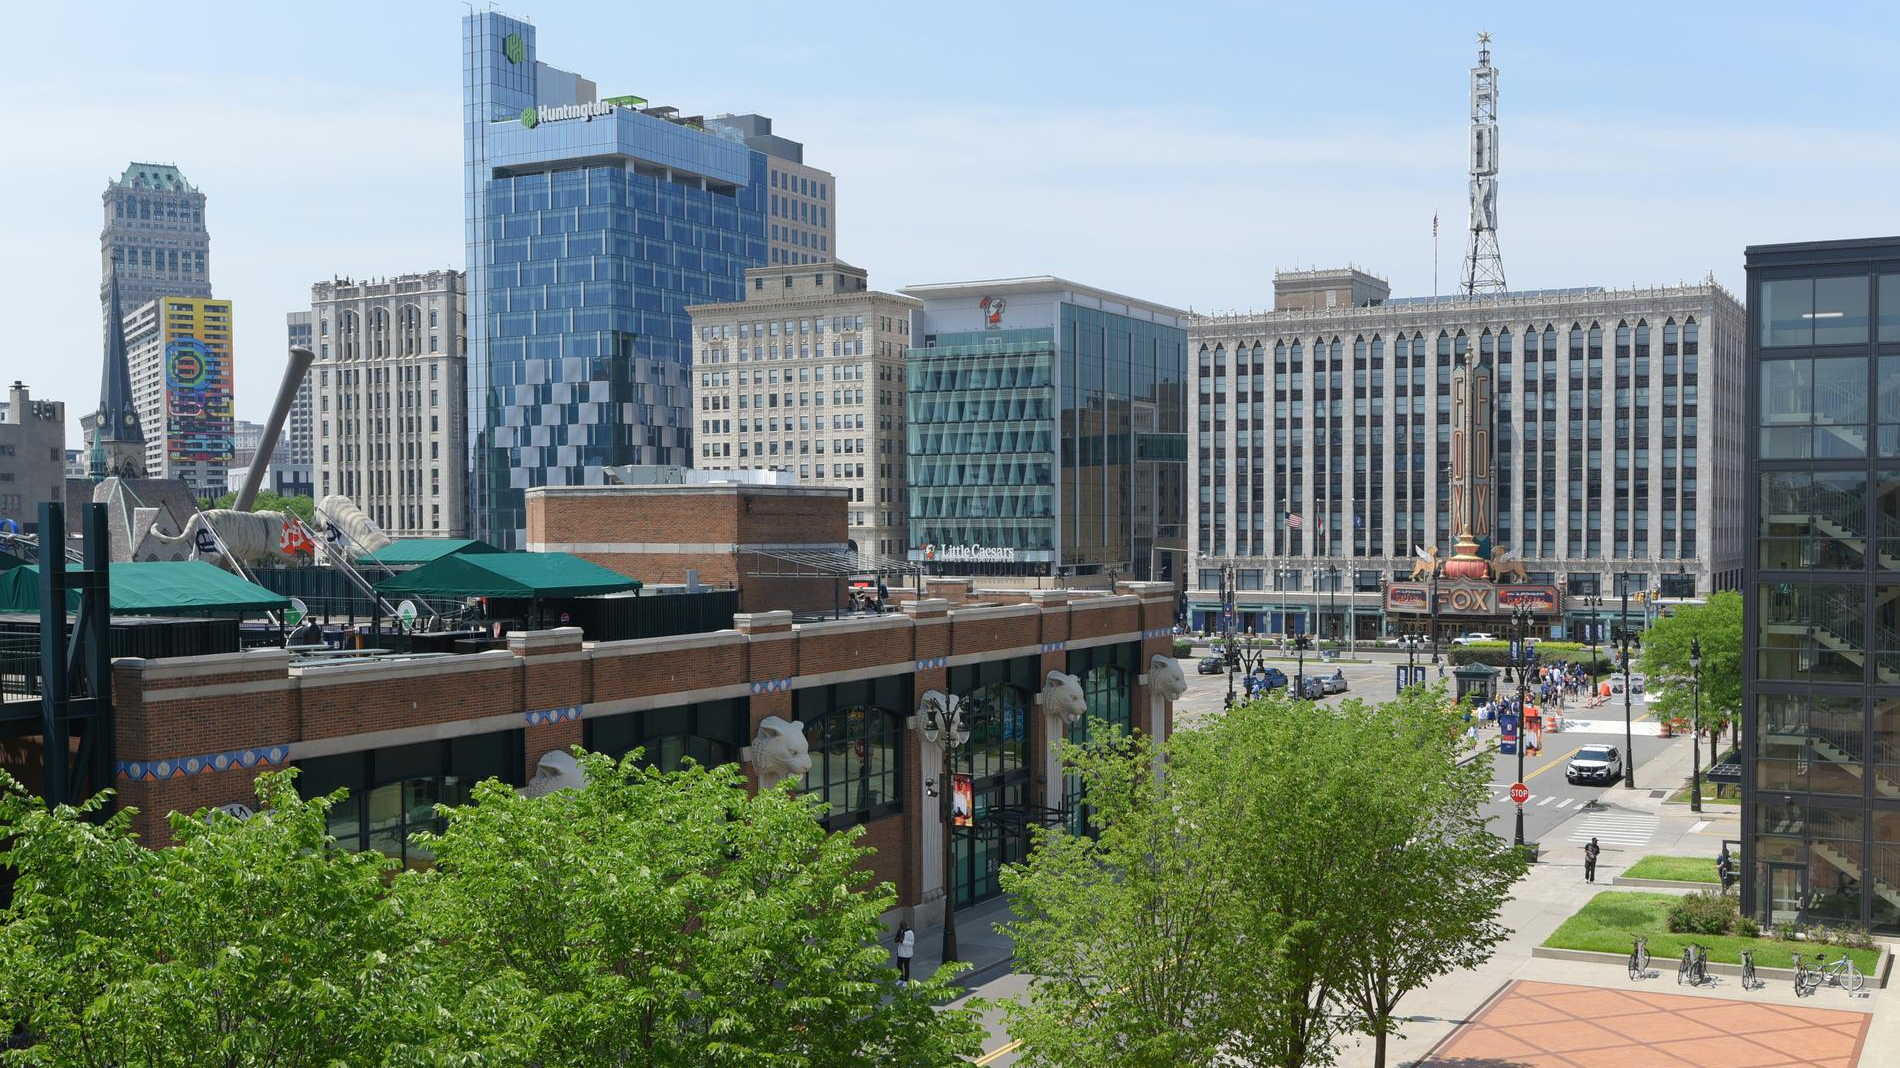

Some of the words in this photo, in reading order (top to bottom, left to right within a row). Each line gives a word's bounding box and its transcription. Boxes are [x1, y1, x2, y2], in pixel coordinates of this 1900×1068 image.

[537, 100, 609, 122] Huntington
[1454, 377, 1464, 535] FOX
[1475, 375, 1488, 535] FOX
[941, 543, 970, 558] Little
[971, 543, 1015, 559] Caesars
[1436, 588, 1489, 611] FOX
[1510, 788, 1528, 798] STOP
